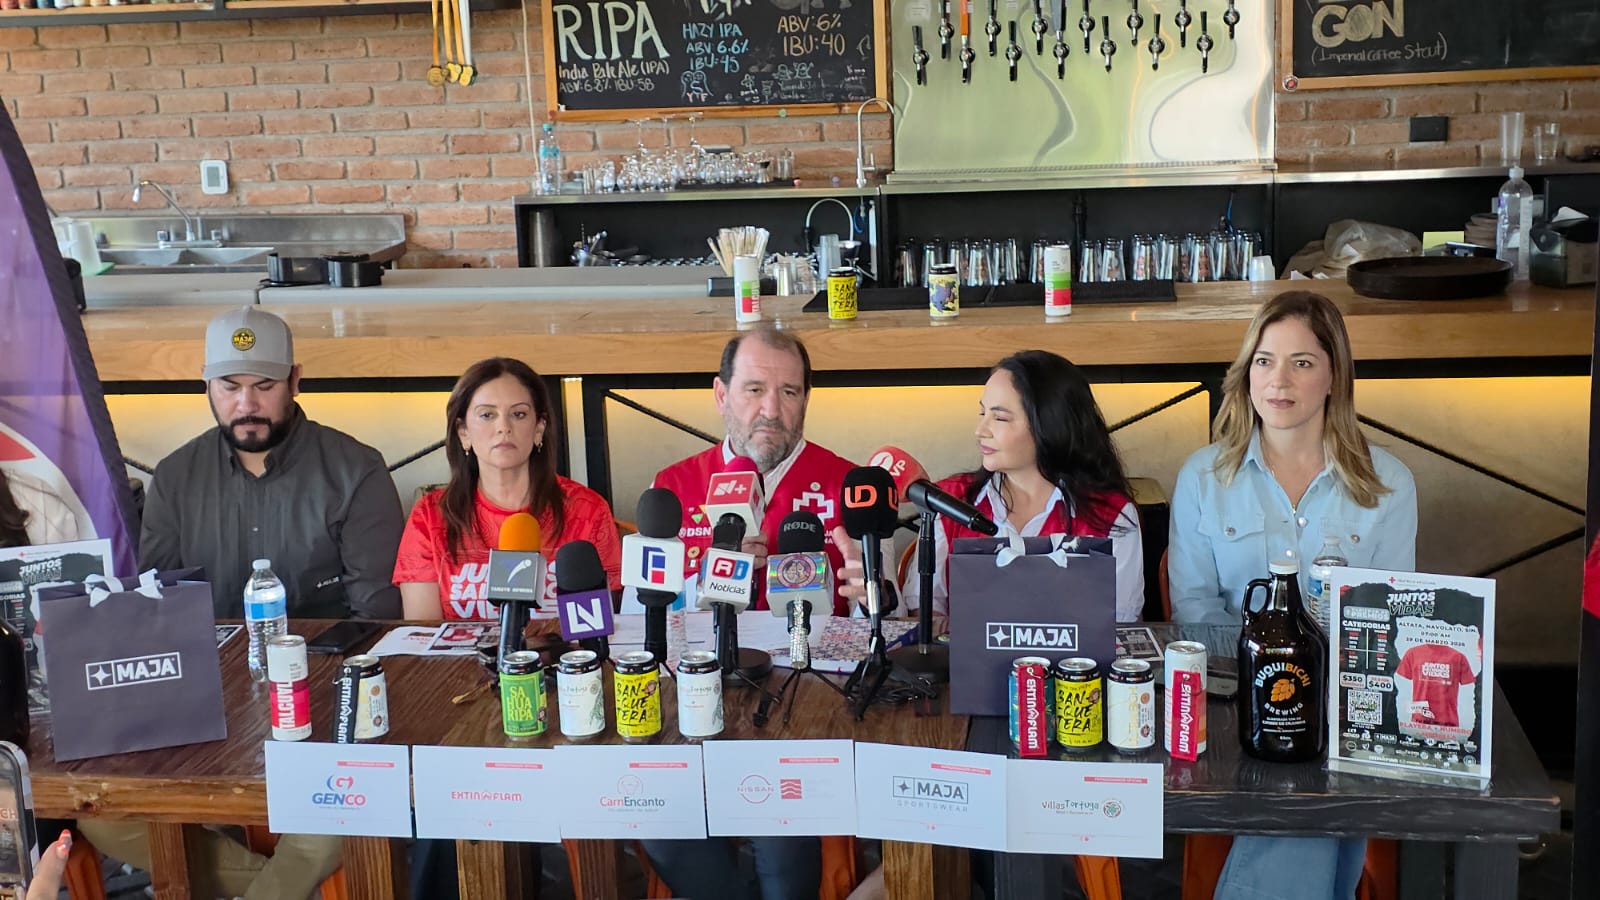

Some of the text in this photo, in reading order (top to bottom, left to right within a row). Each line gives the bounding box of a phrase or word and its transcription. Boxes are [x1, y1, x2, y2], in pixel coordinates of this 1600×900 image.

[1312, 1, 1404, 48] GON
[553, 1, 670, 62] RIPA
[683, 23, 743, 40] HAZY IPA
[559, 60, 670, 80] India Pale Ale (IPA)
[19, 558, 62, 575] JUNTOS
[709, 582, 746, 595] Noticias
[1387, 592, 1436, 603] JUNTOS
[1389, 604, 1436, 616] VIDAS
[1015, 628, 1072, 646] MAJA
[116, 660, 176, 682] MAJA
[1342, 675, 1363, 683] $350
[1368, 681, 1391, 689] $400
[509, 686, 525, 699] SA
[506, 696, 532, 709] HUA
[1264, 702, 1303, 716] BREWING
[508, 708, 533, 721] RIPA
[917, 782, 965, 800] MAJA
[312, 793, 366, 806] GENCO
[599, 796, 665, 807] CarnEncanto
[897, 800, 968, 813] SPORTSWEAR
